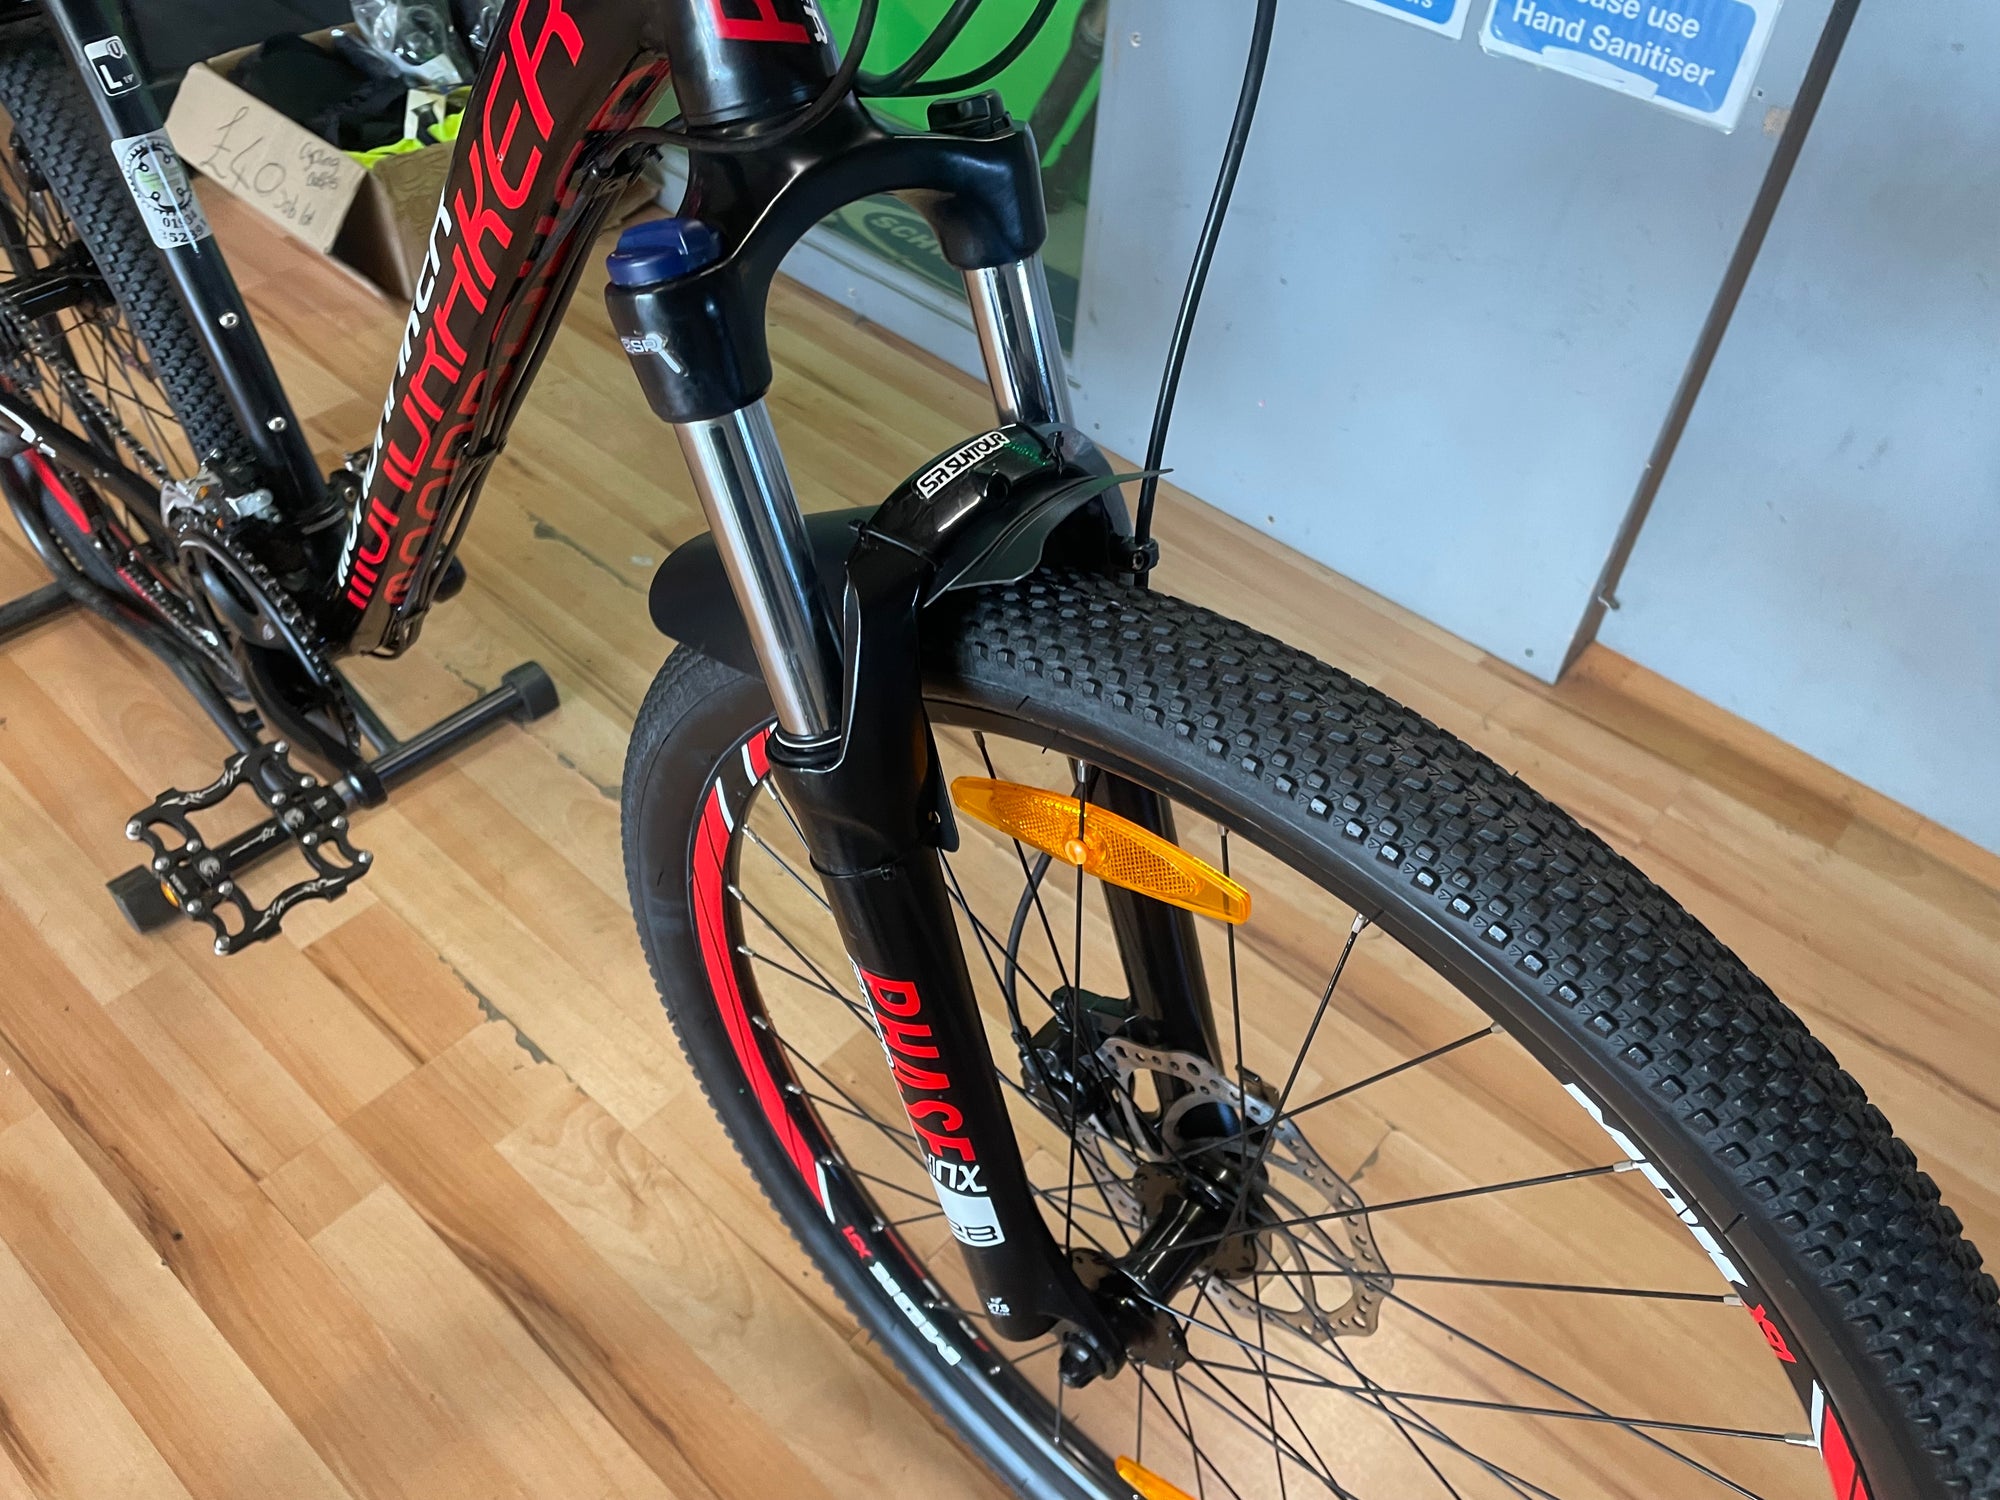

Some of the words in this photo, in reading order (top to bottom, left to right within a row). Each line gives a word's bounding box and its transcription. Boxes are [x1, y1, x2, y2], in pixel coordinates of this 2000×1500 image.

[1513, 0, 1586, 43] Hand
[1589, 25, 1715, 87] Sanitiser
[1647, 5, 1700, 39] use
[200, 106, 286, 194] £40
[919, 467, 950, 495] SR
[944, 433, 1007, 475] SUNTOUR
